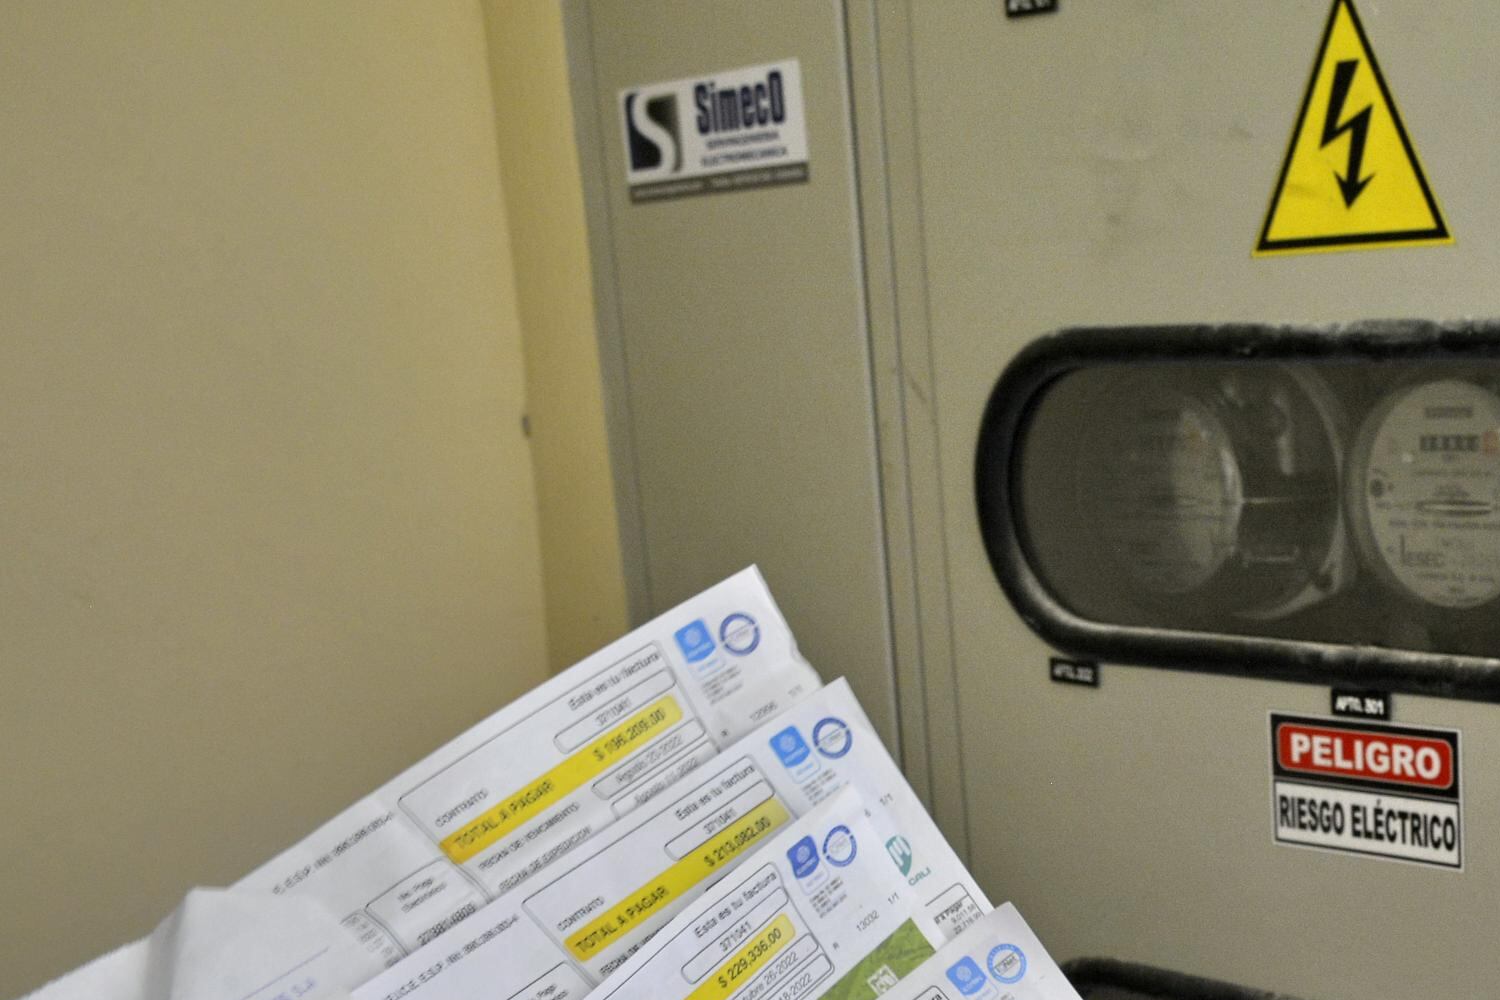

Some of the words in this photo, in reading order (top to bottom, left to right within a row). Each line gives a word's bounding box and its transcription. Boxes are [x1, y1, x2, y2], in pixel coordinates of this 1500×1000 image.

[1290, 732, 1441, 780] PELIGRO
[1279, 795, 1345, 836] RIESGO
[1351, 798, 1456, 851] ELÉCTRICO
[575, 927, 617, 952] TOTAL
[617, 915, 626, 925] A
[626, 887, 665, 916] PAGAR
[704, 855, 715, 866] $
[694, 917, 717, 938] Esta
[718, 907, 731, 920] es
[730, 899, 743, 910] tu
[742, 872, 776, 900] factura
[719, 921, 751, 952] 371041
[718, 976, 727, 988] $
[763, 951, 798, 985] 26-2022
